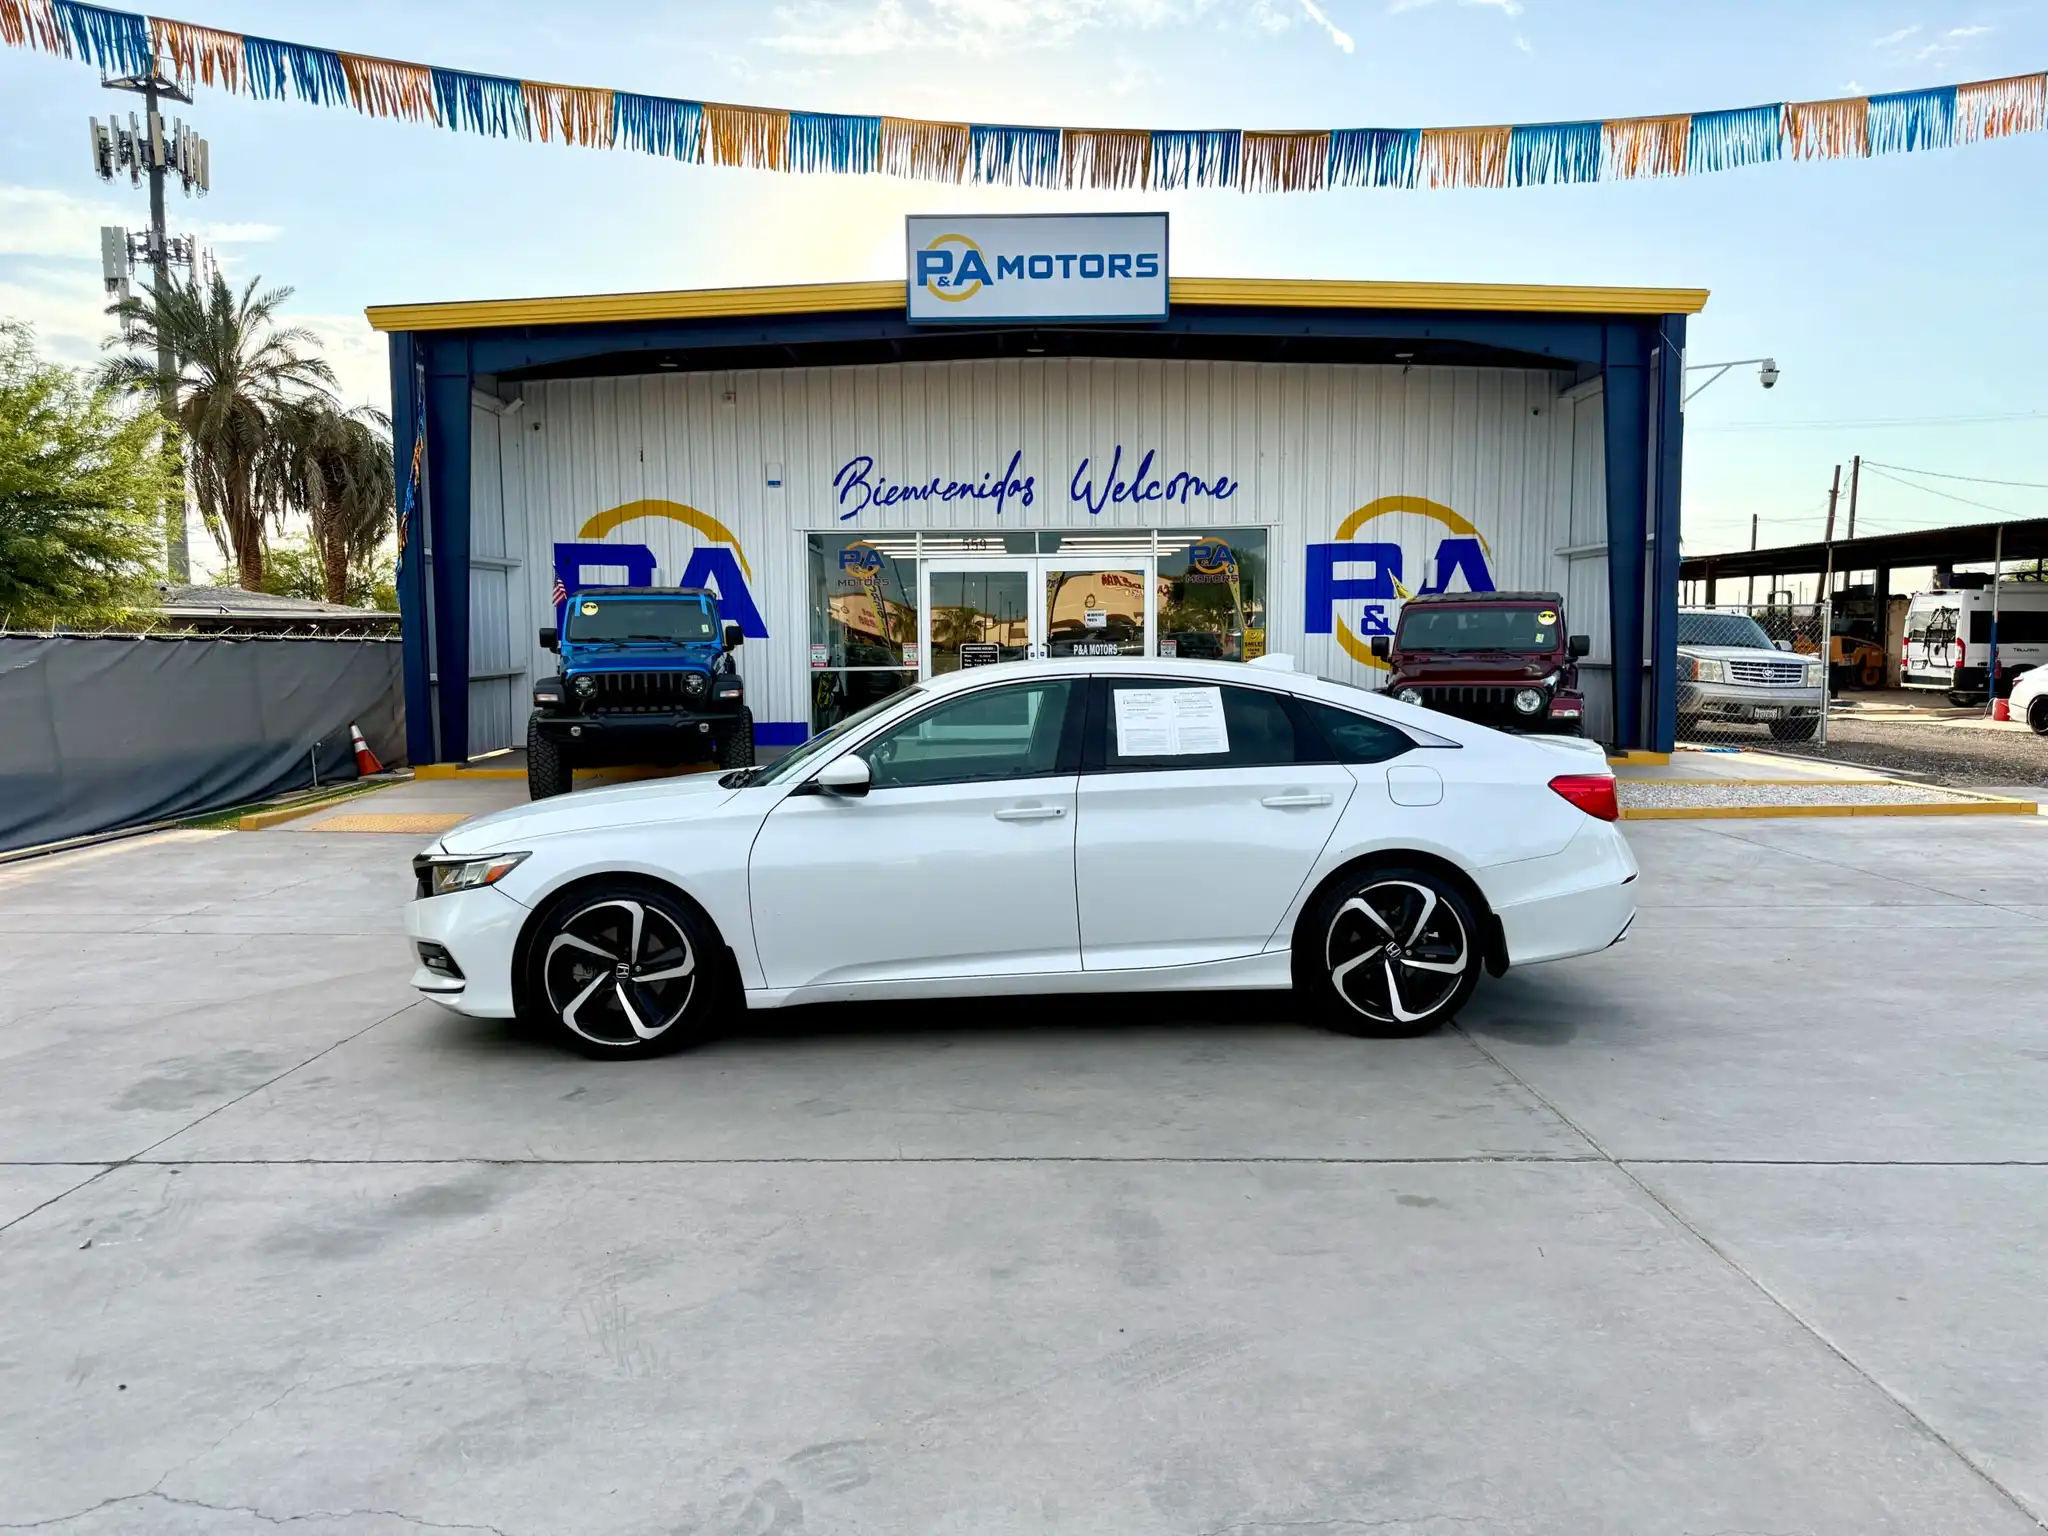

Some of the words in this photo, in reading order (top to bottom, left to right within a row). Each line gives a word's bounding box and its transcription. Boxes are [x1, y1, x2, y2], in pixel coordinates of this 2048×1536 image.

[916, 250, 994, 287] P&A
[997, 253, 1158, 280] MOTORS
[833, 450, 1034, 520] Bienvenidos
[1071, 445, 1237, 514] Welcome
[837, 579, 890, 587] MOTORS
[1184, 574, 1240, 584] MOTORS
[1073, 643, 1089, 656] P&A
[1090, 643, 1118, 656] MOTORS
